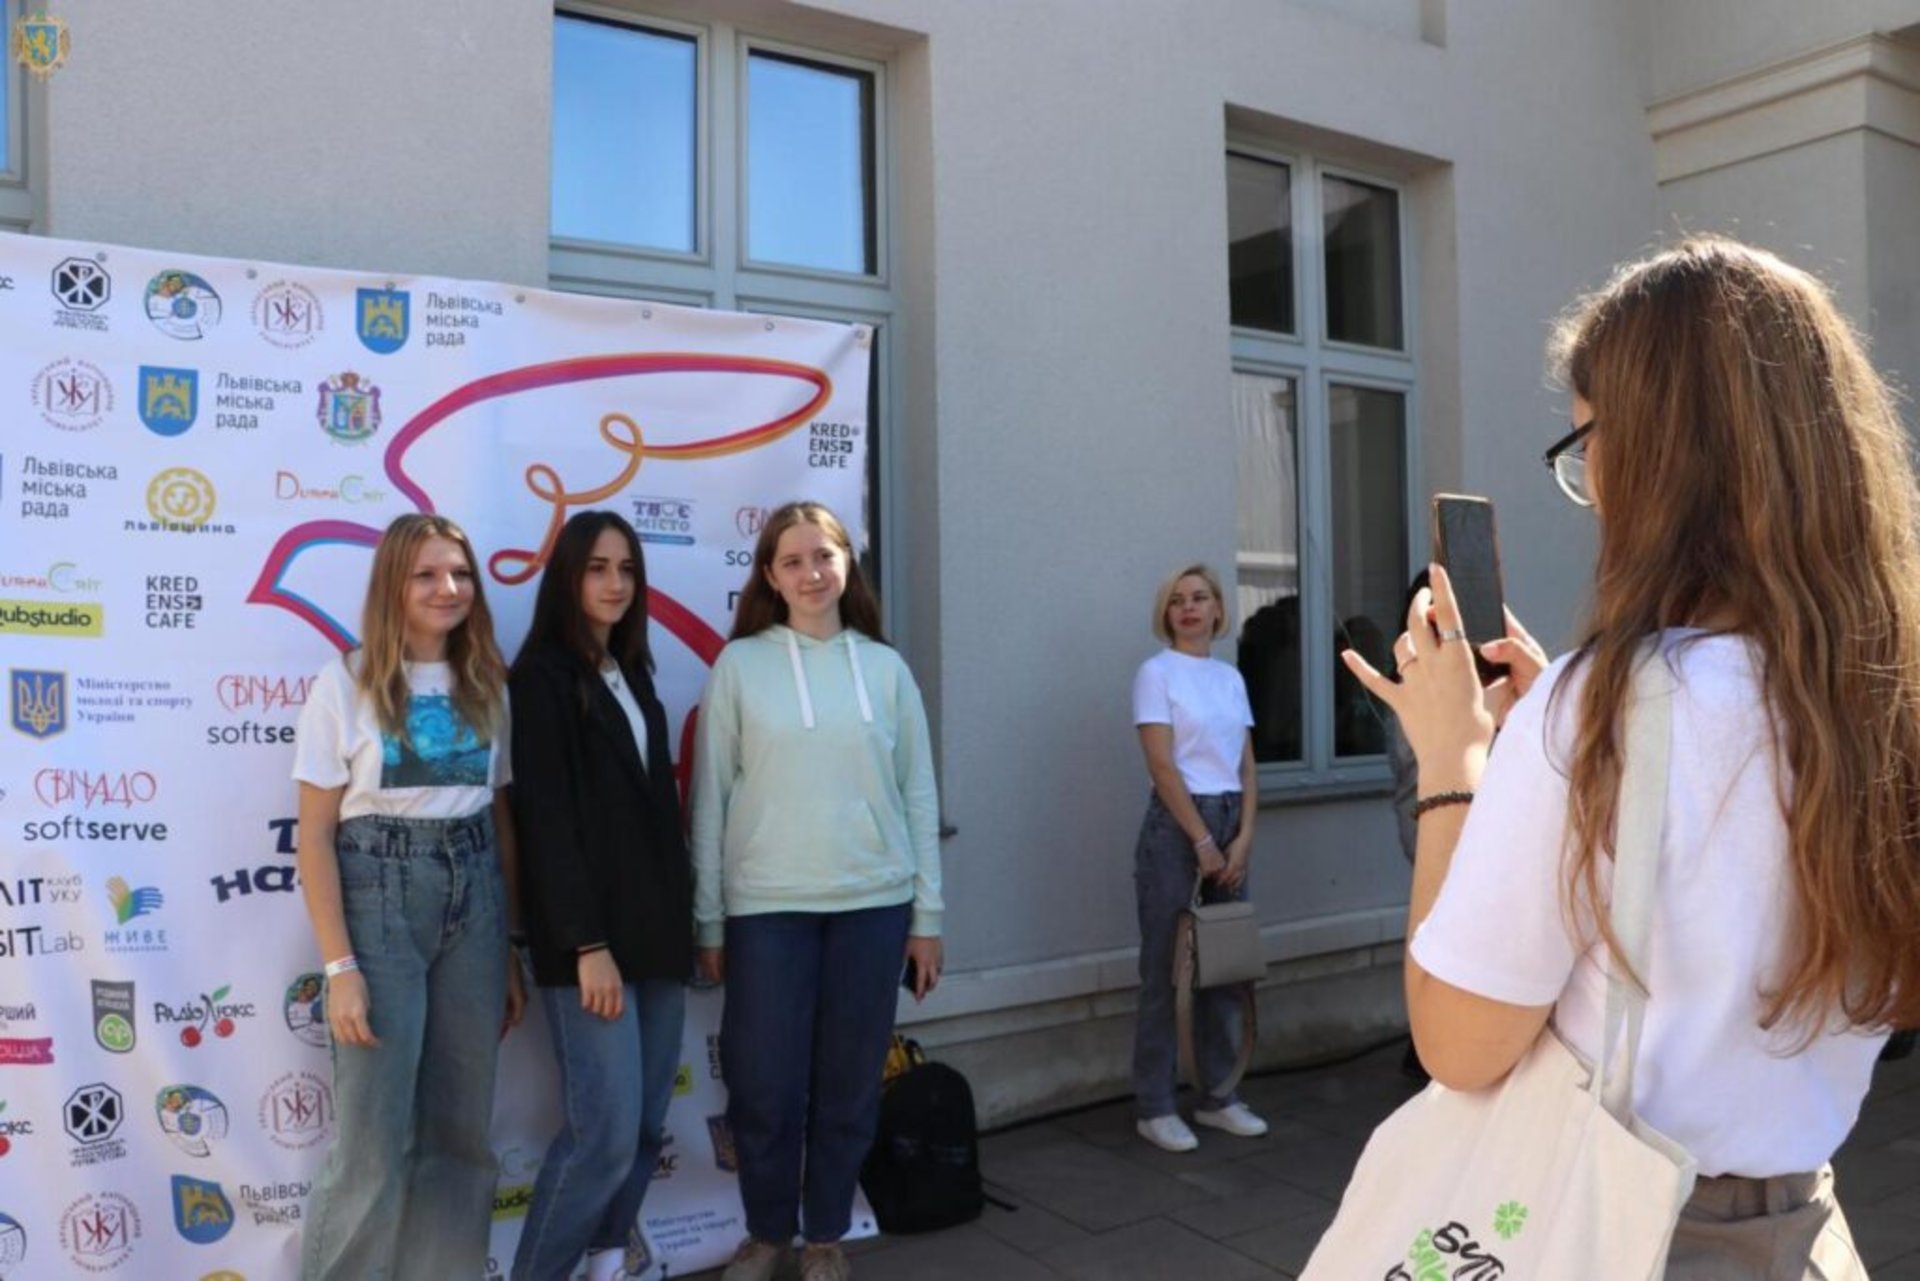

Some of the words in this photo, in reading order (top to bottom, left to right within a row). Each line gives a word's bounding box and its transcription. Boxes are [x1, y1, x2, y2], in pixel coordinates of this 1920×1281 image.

[425, 292, 503, 315] Львівська
[426, 312, 479, 328] міська
[426, 331, 465, 347] рада
[216, 372, 302, 393] Львівська
[216, 393, 275, 410] міська
[216, 412, 259, 430] рада
[810, 423, 850, 438] KRED
[809, 438, 839, 453] ENS
[22, 456, 118, 480] Львівська
[808, 454, 848, 469] CAFE
[22, 479, 87, 498] міська
[22, 501, 70, 519] рада
[146, 576, 198, 592] KRED
[146, 595, 184, 610] ENS
[146, 613, 196, 629] CAFE
[207, 721, 296, 744] softse
[24, 814, 168, 841] softserve
